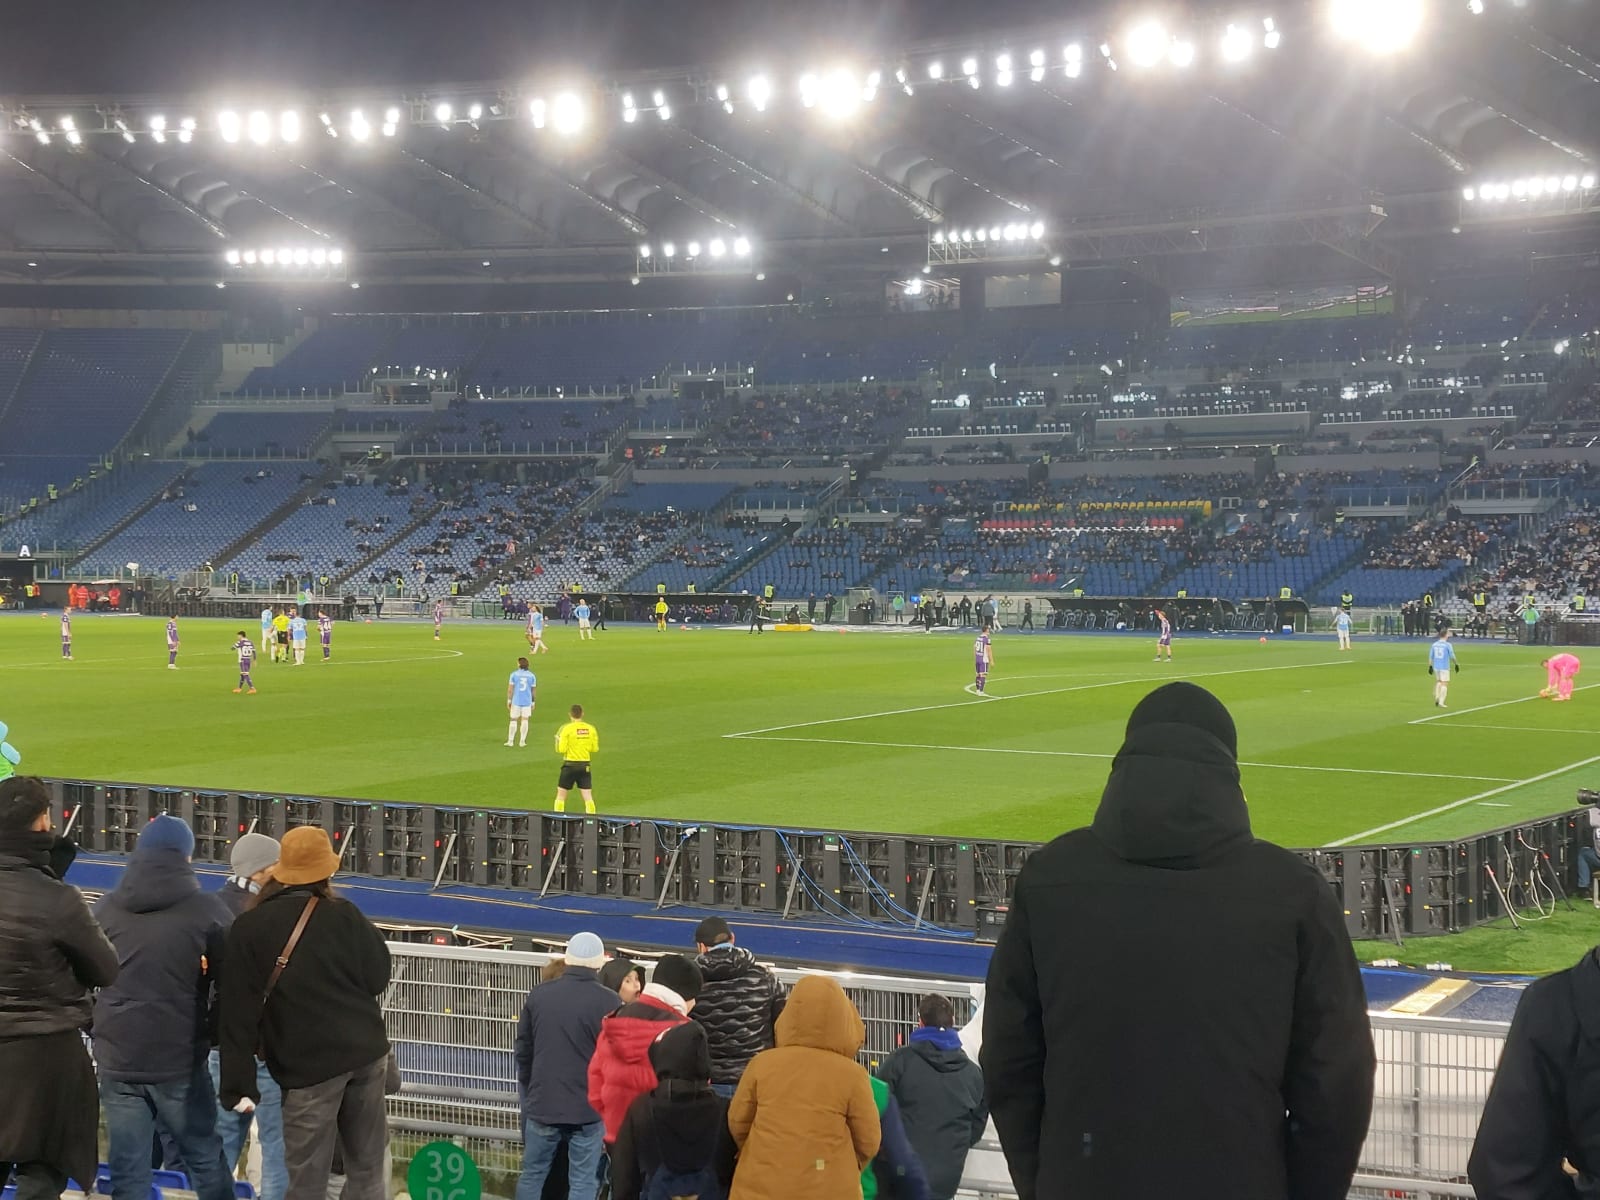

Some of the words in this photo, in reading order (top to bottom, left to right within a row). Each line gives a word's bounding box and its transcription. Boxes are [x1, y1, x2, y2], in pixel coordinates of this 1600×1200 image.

[19, 544, 31, 557] A
[976, 641, 984, 652] 91
[519, 677, 528, 691] 3
[427, 1150, 465, 1184] 39
